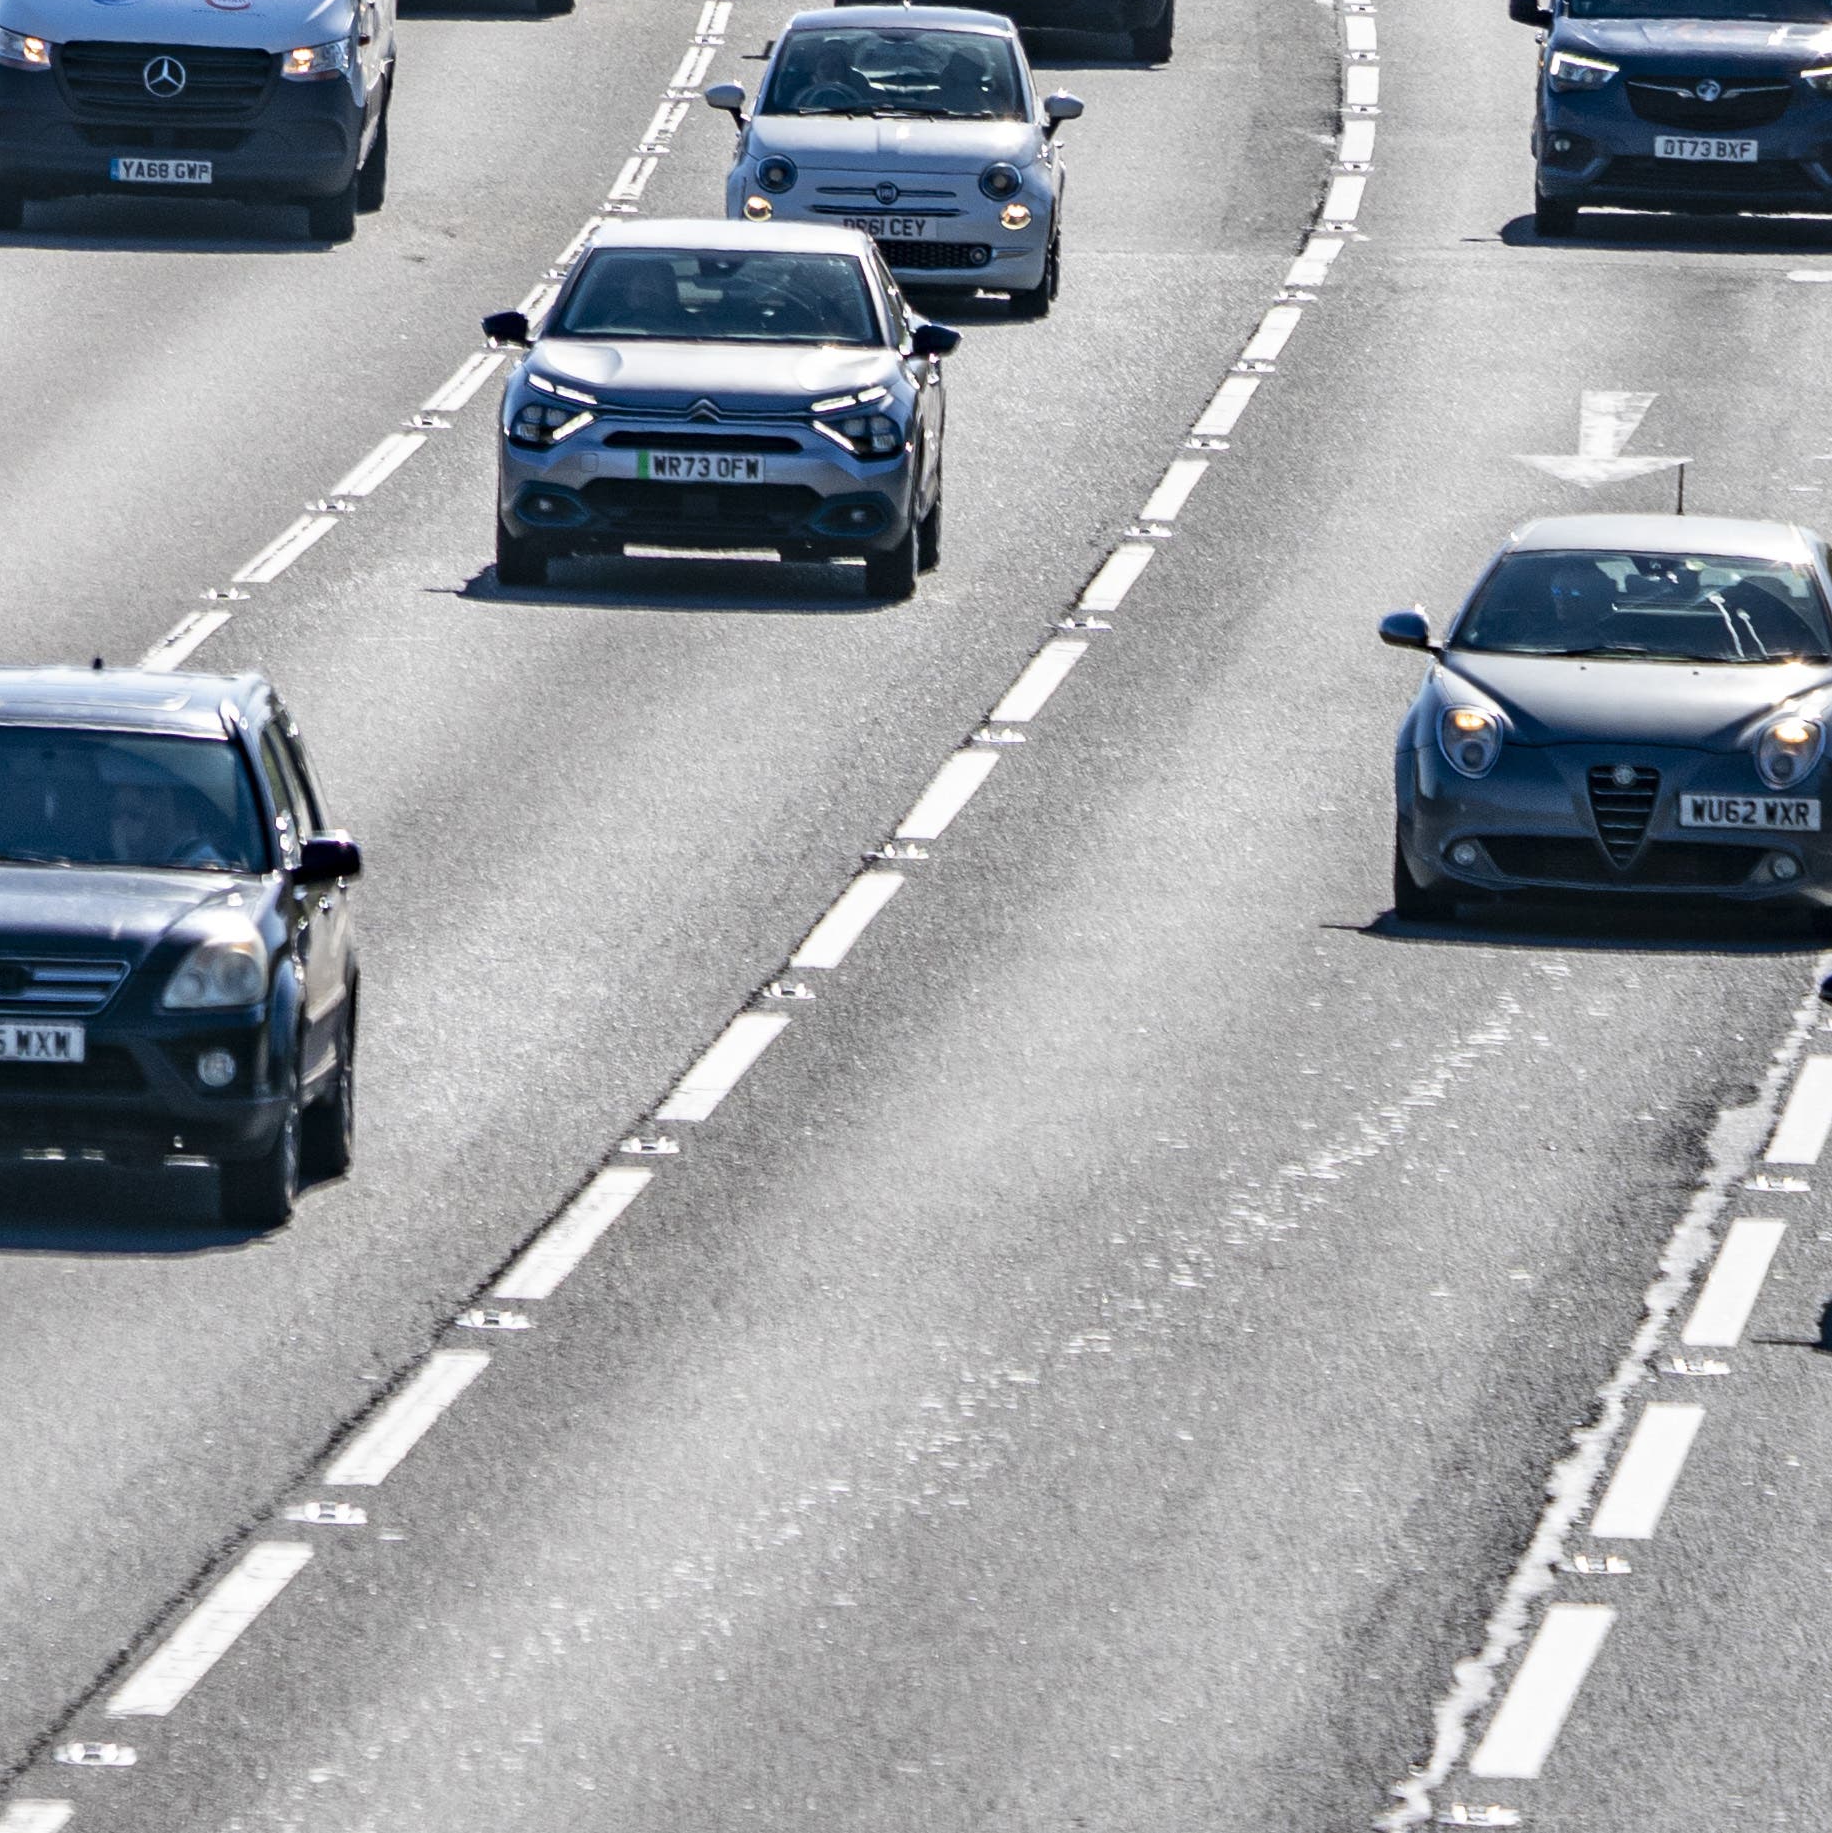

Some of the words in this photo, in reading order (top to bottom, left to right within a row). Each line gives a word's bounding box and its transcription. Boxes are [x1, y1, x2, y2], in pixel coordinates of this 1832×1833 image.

[1663, 139, 1711, 158] DT73
[1716, 140, 1752, 159] BXF
[122, 160, 169, 179] YA68
[174, 162, 210, 181] GWP
[889, 217, 927, 237] CEY
[652, 454, 710, 479] WR73
[717, 456, 761, 481] OFW
[1691, 798, 1758, 826] WU62
[1762, 800, 1811, 828] WXR
